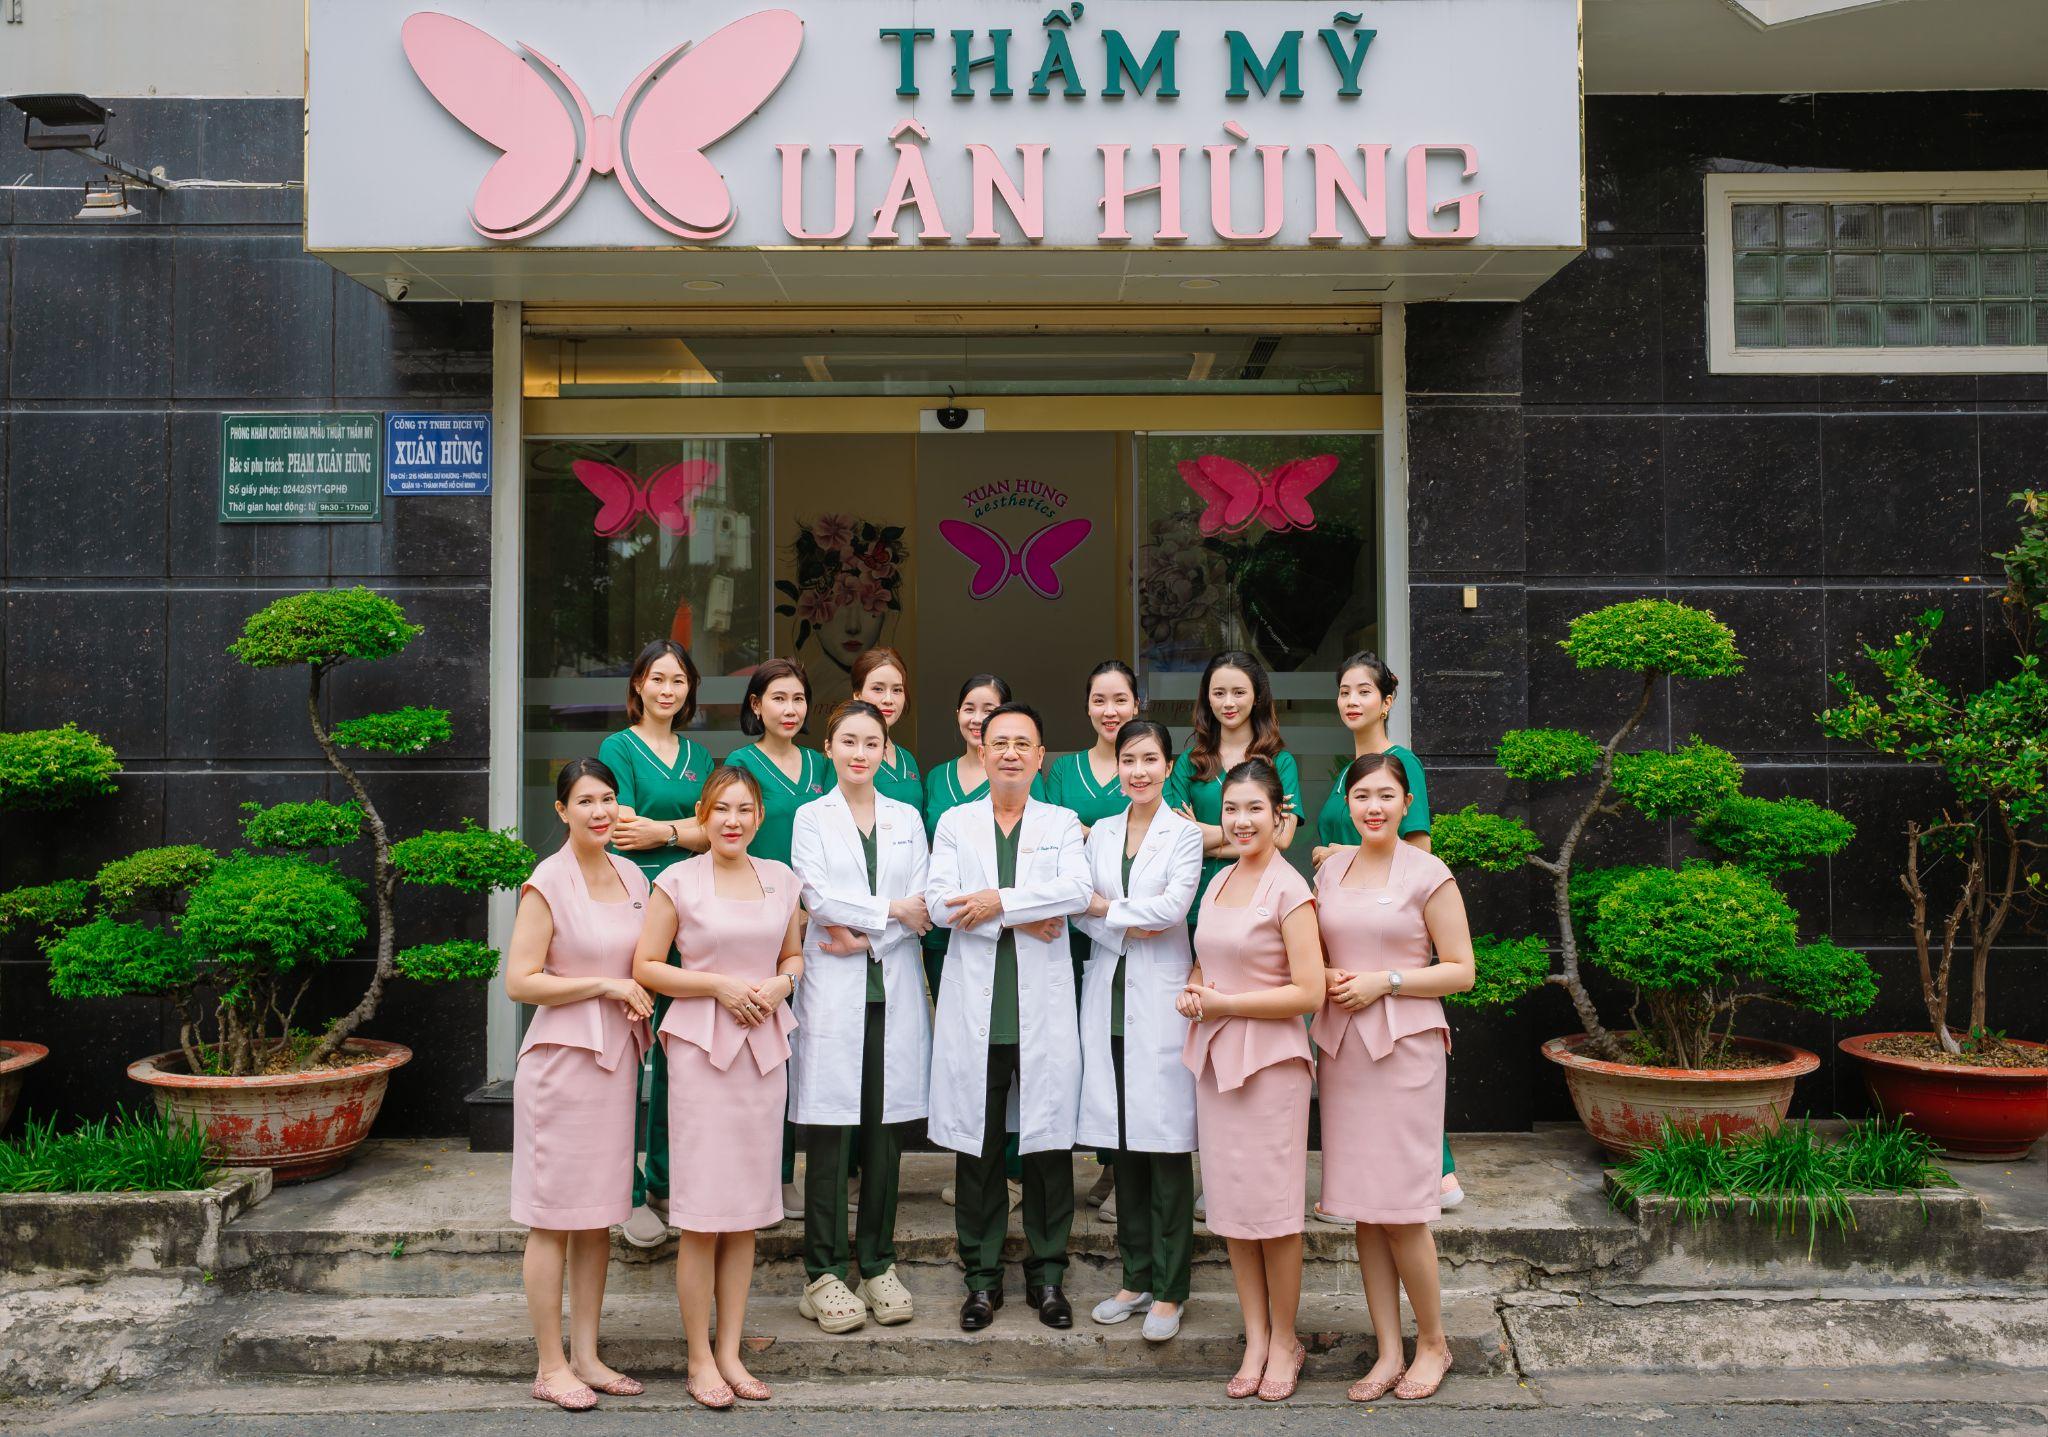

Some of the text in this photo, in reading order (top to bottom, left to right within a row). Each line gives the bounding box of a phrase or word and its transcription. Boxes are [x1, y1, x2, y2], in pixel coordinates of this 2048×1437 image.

[879, 2, 1377, 99] THẨM MỸ
[1096, 120, 1485, 241] HÙNG
[230, 424, 250, 440] PHÒNG
[250, 424, 268, 440] KHÁM
[269, 424, 292, 440] CHUYÊN
[293, 426, 309, 440] KHOA
[327, 424, 345, 442] THUẬT
[394, 419, 485, 432] CÔNG TY TNHH DỊCH VỤ
[229, 457, 242, 473] Bác
[250, 459, 263, 476] phụ
[264, 457, 284, 473] trách:
[287, 453, 314, 478] PHẠM
[316, 448, 343, 473] XUÂN
[344, 448, 371, 473] HÙNG
[395, 434, 483, 465] XUÂN HÙNG
[229, 483, 348, 496] Số giấy phép: 02442/SYT-GPHĐ
[962, 479, 1069, 508] XUAN HUNG
[229, 502, 246, 511] Thời
[247, 502, 264, 513] gian
[265, 502, 283, 513] hoạt
[284, 502, 307, 513] động:
[974, 493, 1056, 519] aesthetics
